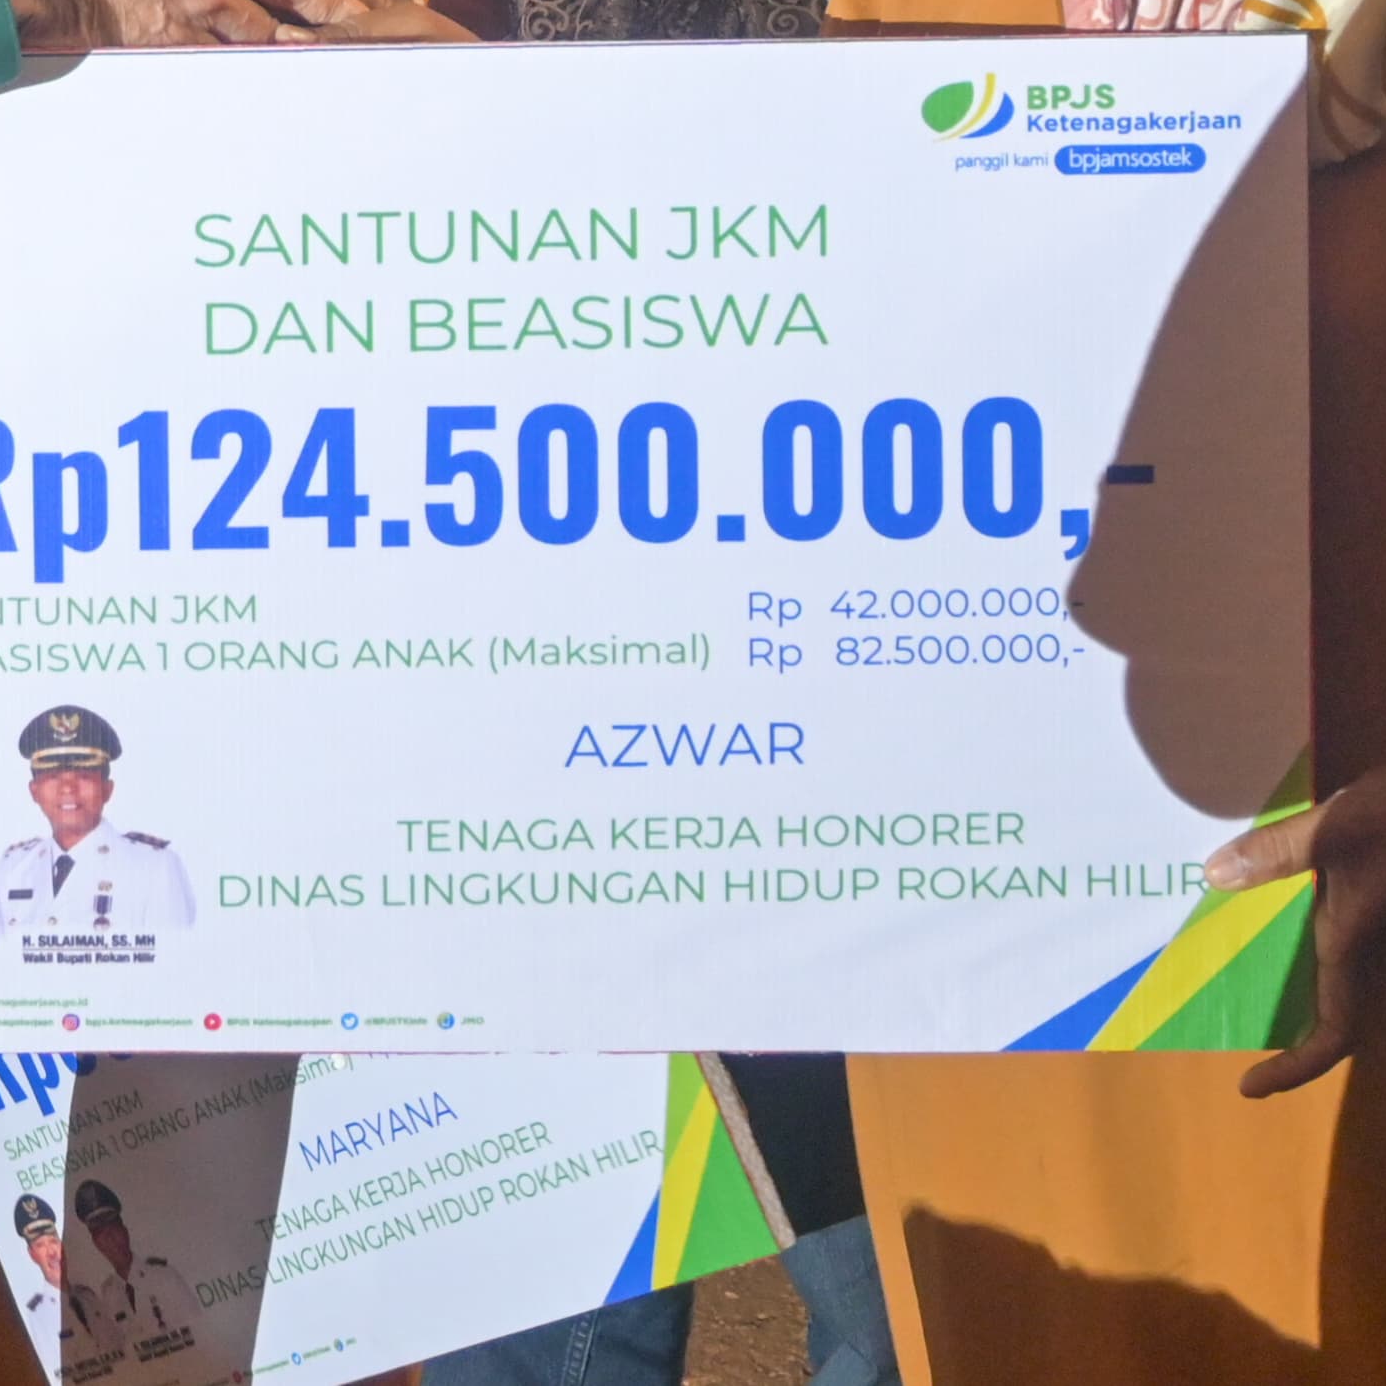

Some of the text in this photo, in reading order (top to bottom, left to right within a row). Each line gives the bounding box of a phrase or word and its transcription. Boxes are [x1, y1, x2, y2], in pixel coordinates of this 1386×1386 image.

[1027, 84, 1116, 109] BPJS
[1027, 111, 1242, 134] Ketenagakerjaan
[955, 146, 1192, 173] panggil kami bpjamsostek
[195, 204, 827, 268] SANTUNAN JKM
[206, 292, 829, 355] DAN BEASISWA
[172, 595, 256, 624] JKM
[749, 587, 1084, 628] Rp 42.000.000,-
[157, 642, 167, 670] 1
[184, 640, 338, 671] ORANG
[353, 638, 473, 668] ANAK
[490, 633, 709, 674] (Maksimal)
[749, 634, 1085, 674] Rp 82.500.000,-
[565, 722, 804, 768] AZWAR
[397, 812, 1024, 852] TENAGA KERJA HONORER
[220, 863, 1208, 907] DINAS LINGKUNGAN HIDUP ROKAN HILIR
[23, 952, 155, 966] Wakil Bupati Rokan Hilir
[37, 934, 110, 949] SULAIMAN,
[134, 934, 156, 947] MH
[3, 1089, 144, 1162] SANTUNAN JKM
[15, 1136, 113, 1191] BEASISWA
[121, 1106, 191, 1151] ORANG
[194, 1084, 253, 1130] ANAK
[299, 1091, 459, 1172] MARYANA
[255, 1120, 553, 1242] TENAGA KERJA HONORER
[195, 1129, 665, 1309] DINAS LINGKUNGAN HIDUP ROKAN HILIR
